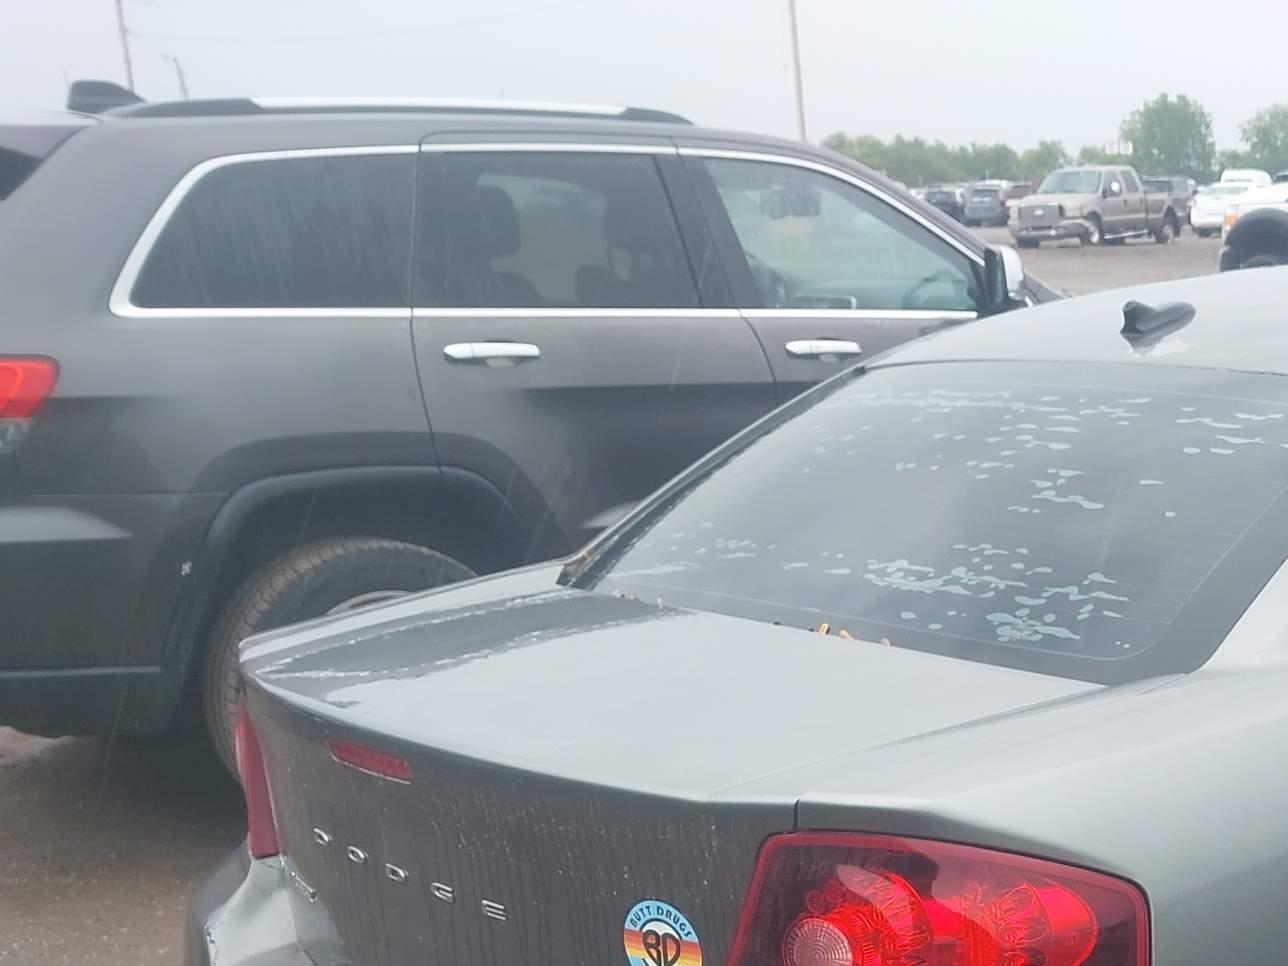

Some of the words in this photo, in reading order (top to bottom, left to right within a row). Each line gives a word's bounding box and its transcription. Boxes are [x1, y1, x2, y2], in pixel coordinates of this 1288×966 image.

[313, 826, 507, 921] DODGE
[629, 905, 652, 928] BUTT
[656, 906, 693, 938] DRUGS
